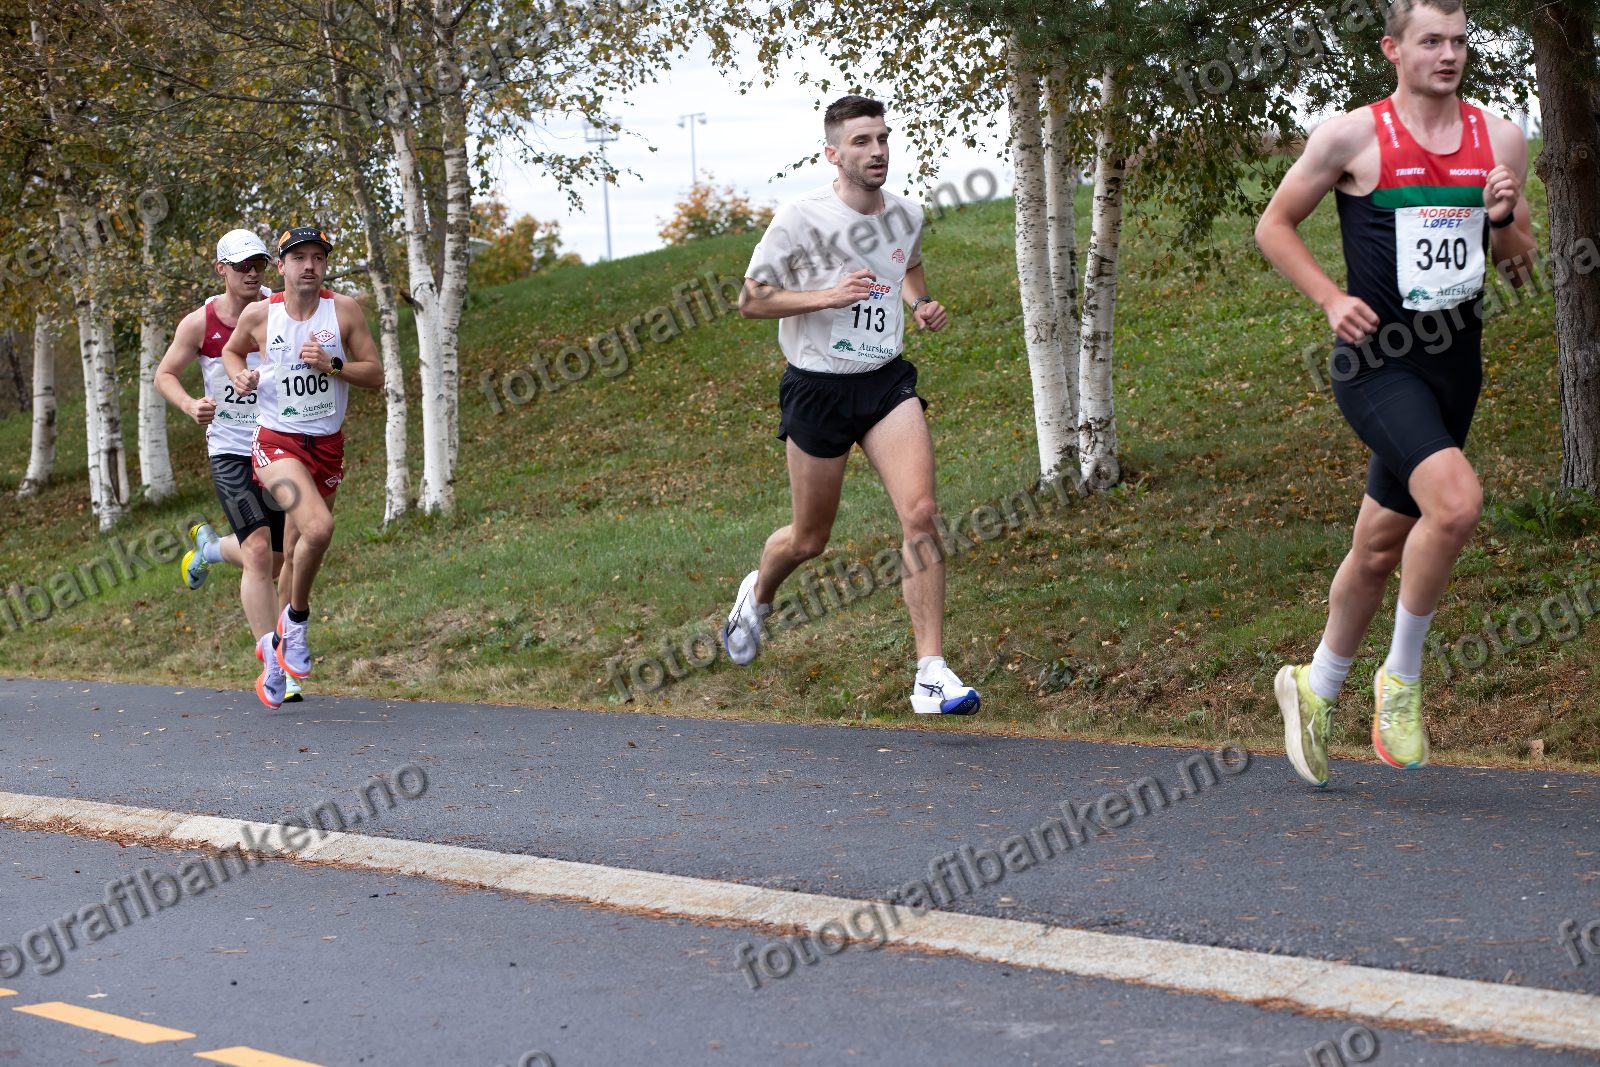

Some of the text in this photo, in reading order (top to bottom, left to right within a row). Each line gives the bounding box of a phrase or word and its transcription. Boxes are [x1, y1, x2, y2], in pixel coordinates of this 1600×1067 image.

[1418, 208, 1472, 218] NORGES
[1423, 219, 1463, 229] LØPET
[1416, 237, 1467, 271] 340
[868, 282, 892, 294] RGES
[869, 290, 885, 300] PET
[851, 303, 886, 333] 113
[858, 341, 894, 357] Aurskog
[290, 363, 312, 371] LØPE
[281, 372, 329, 396] 1006
[302, 401, 333, 412] Aurskog
